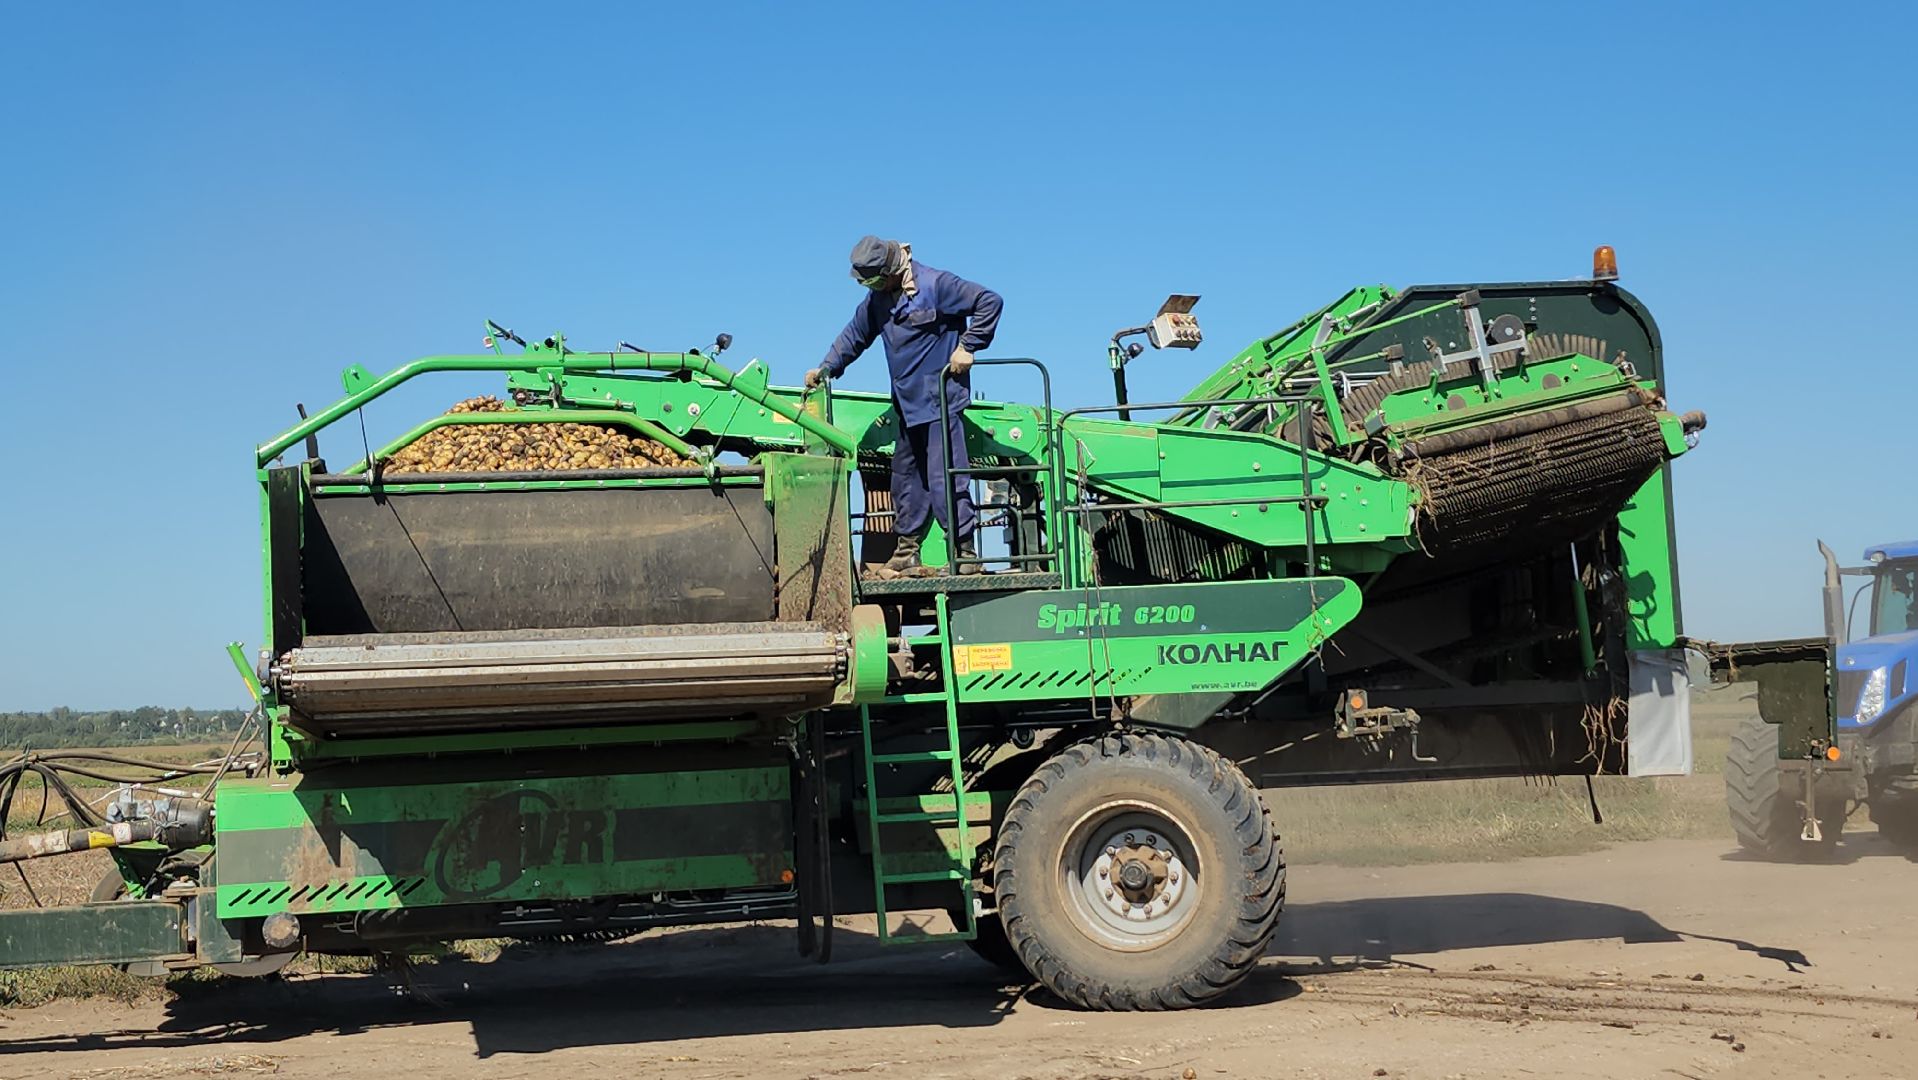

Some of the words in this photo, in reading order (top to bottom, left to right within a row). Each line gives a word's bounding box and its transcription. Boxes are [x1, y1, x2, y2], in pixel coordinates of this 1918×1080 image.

[1037, 601, 1122, 634] Spirit
[1134, 604, 1196, 625] 6200
[1157, 640, 1289, 666] КОЛНАГ
